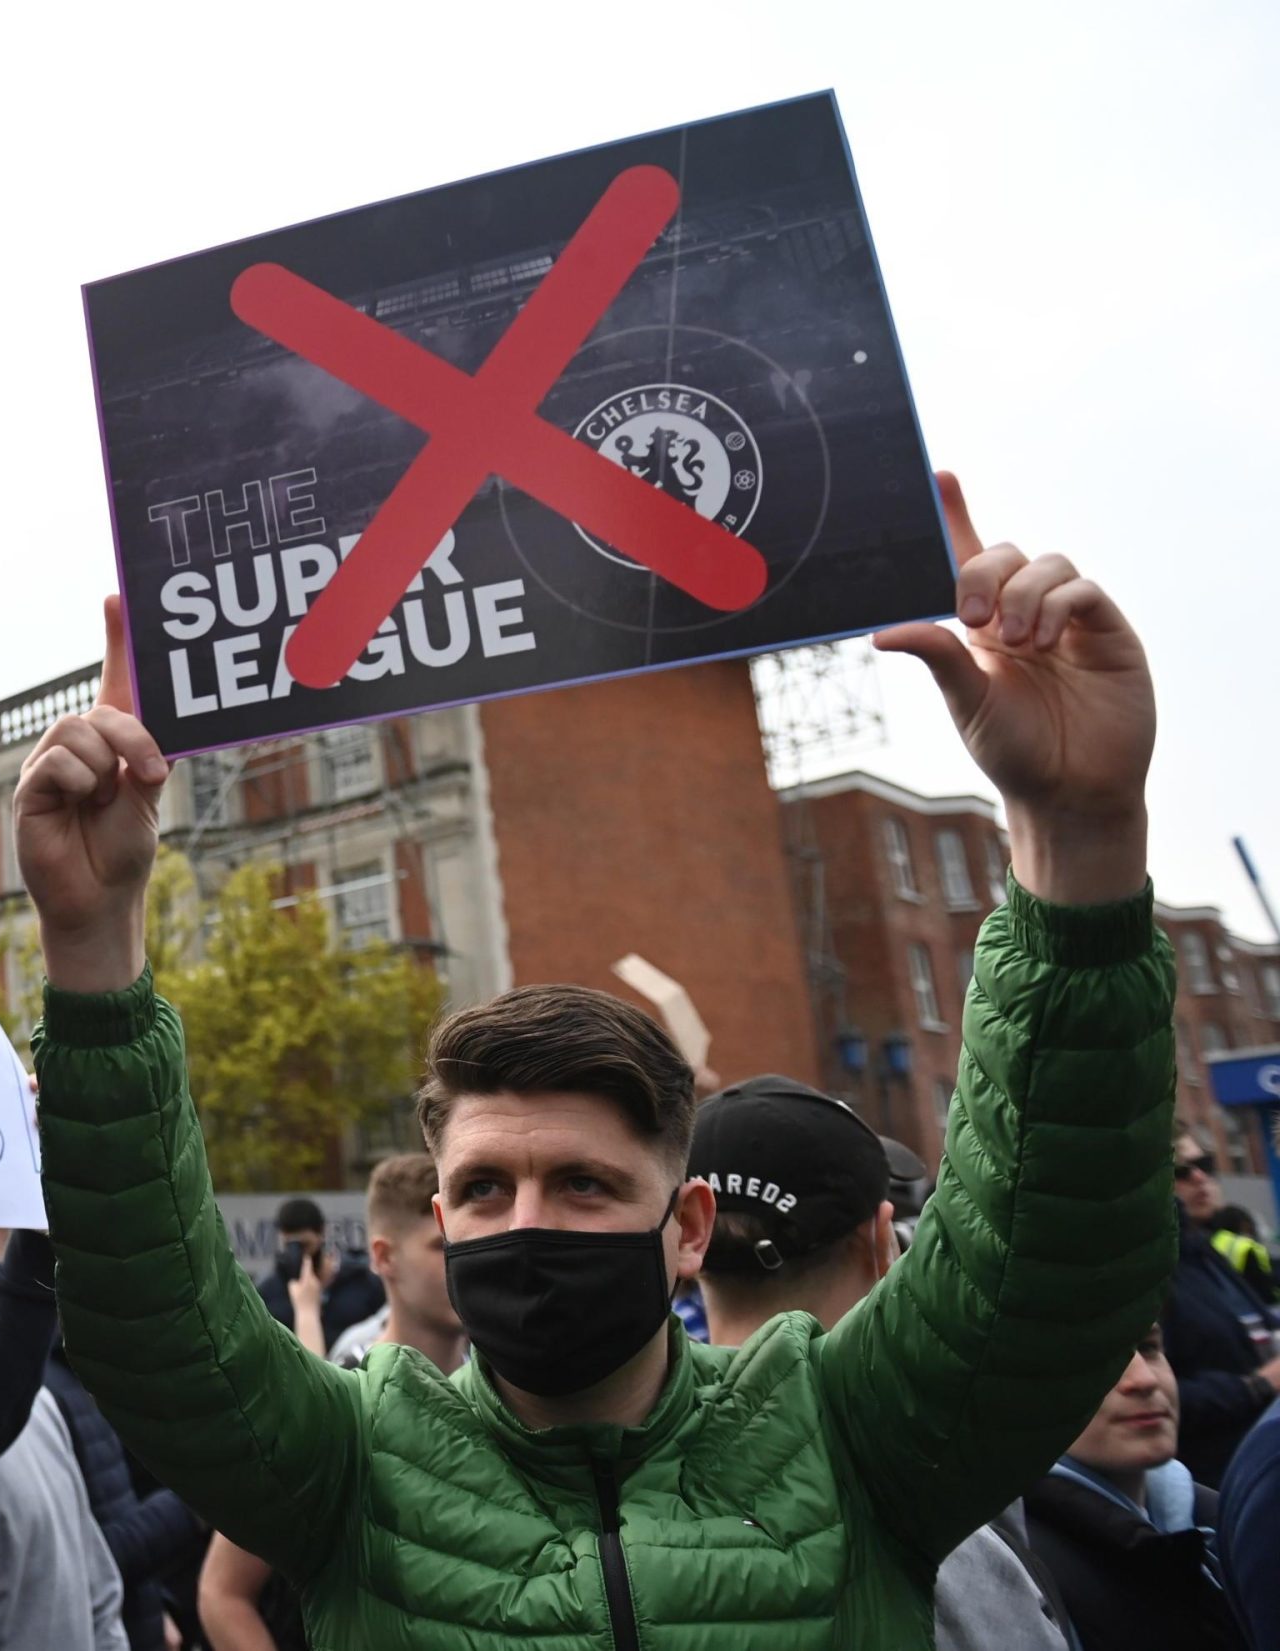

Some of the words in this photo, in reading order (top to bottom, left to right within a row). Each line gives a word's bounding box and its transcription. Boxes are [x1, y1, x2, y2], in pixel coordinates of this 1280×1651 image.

[586, 390, 708, 440] CHELSEA
[148, 467, 326, 567] THE
[159, 527, 465, 640] SUPR
